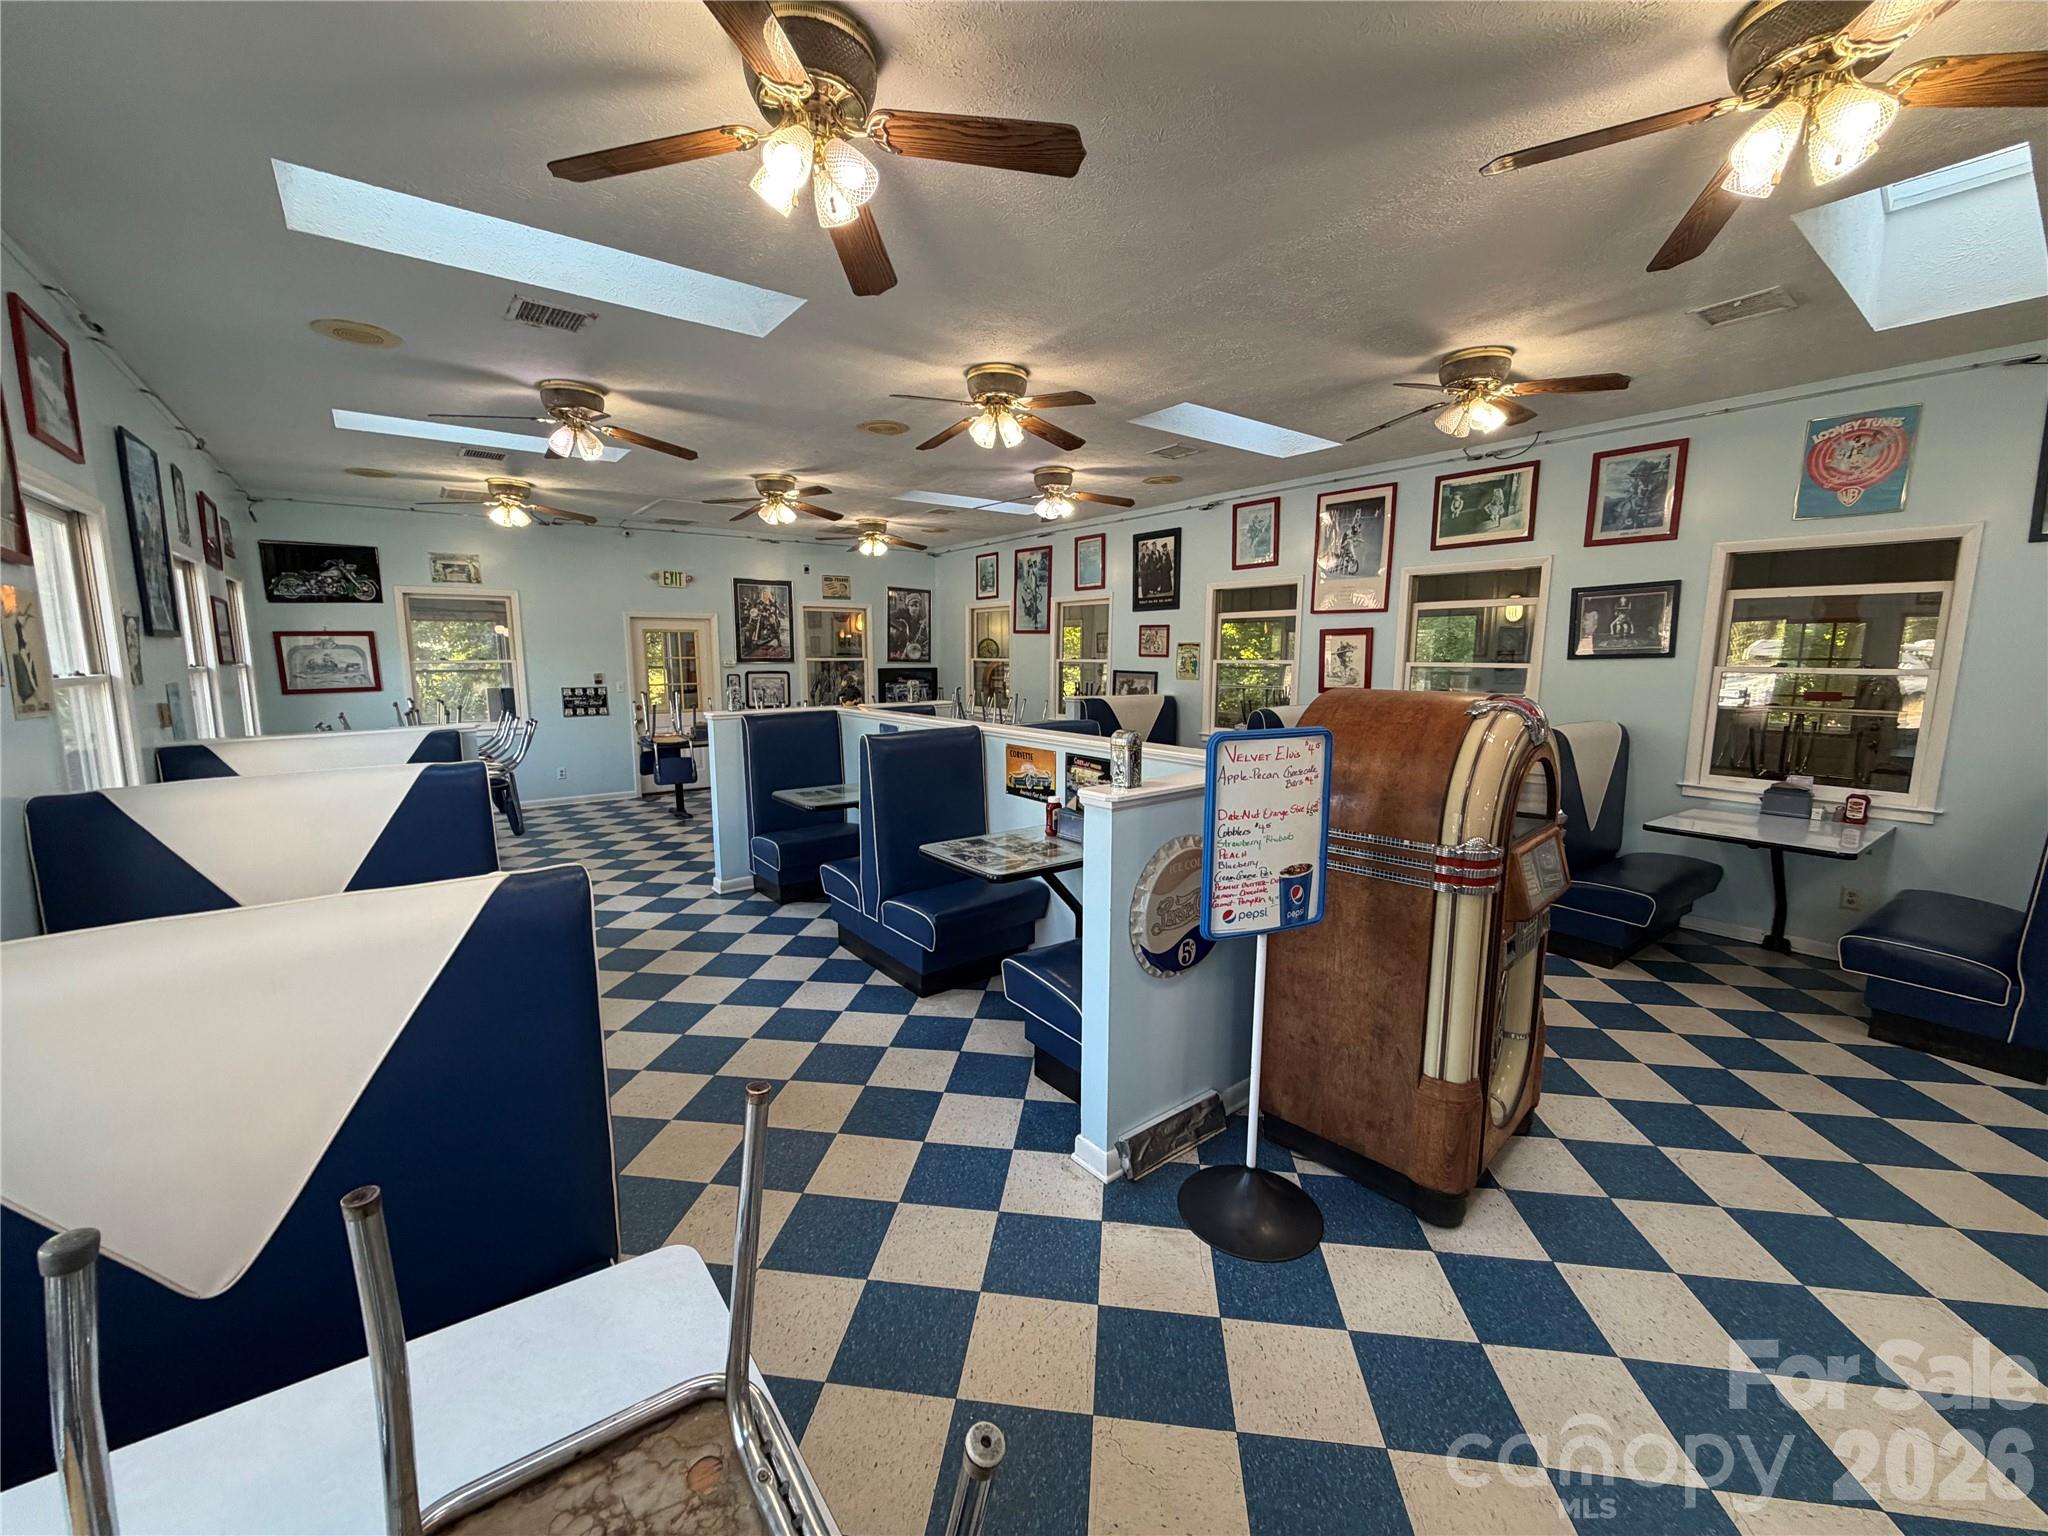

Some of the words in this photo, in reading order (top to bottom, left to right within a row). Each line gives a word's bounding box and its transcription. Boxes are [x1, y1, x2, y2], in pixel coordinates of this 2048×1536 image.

[1812, 420, 1861, 444] LOONEY
[1862, 416, 1906, 429] TUNES
[663, 570, 683, 587] EXIT
[1009, 749, 1034, 761] CORVETTE
[1275, 745, 1301, 761] Elvis
[1217, 765, 1280, 786] Apple-Pecan
[1217, 823, 1251, 838] Cobblers
[1216, 839, 1261, 850] Strawberry
[1169, 861, 1184, 875] ICE
[1184, 856, 1201, 871] COL
[1217, 860, 1259, 870] Blueberry
[1238, 907, 1268, 921] pepsi
[1286, 907, 1305, 919] pepsi
